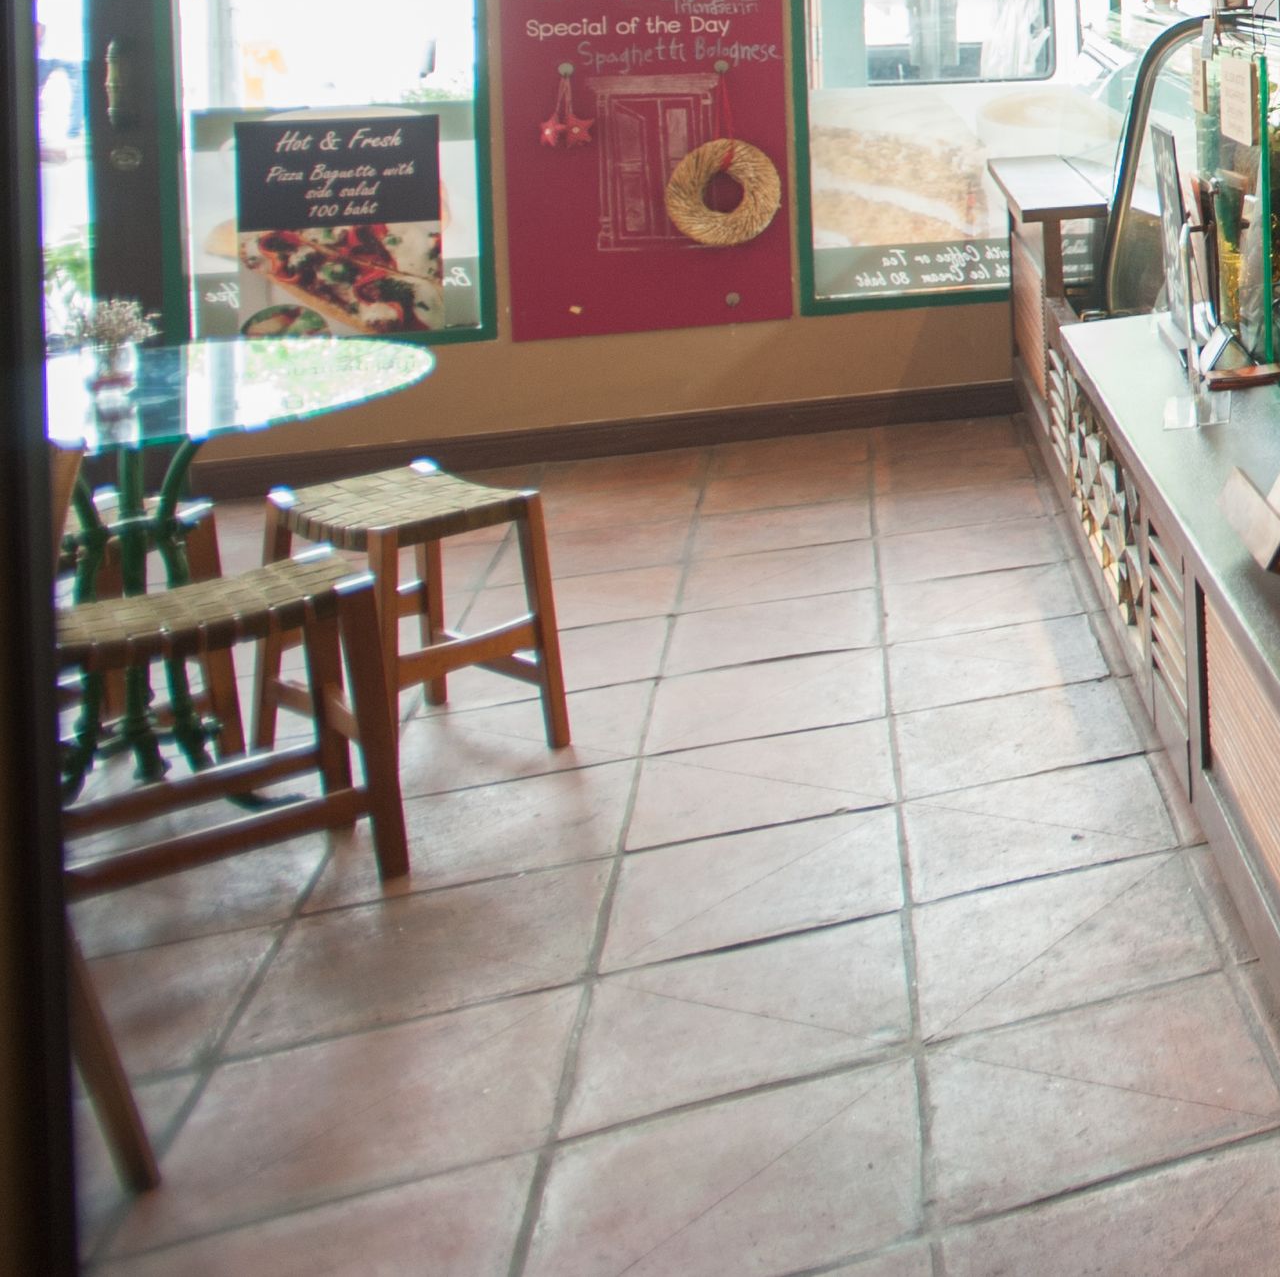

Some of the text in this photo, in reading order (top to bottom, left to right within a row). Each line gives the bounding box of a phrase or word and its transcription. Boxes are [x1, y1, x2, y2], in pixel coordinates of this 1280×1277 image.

[526, 16, 730, 41] Special of the Day
[275, 127, 402, 153] Hot & Fresh
[265, 160, 415, 189] Pizza Baguette with
[305, 180, 381, 199] side salad
[308, 200, 378, 217] 100 baht
